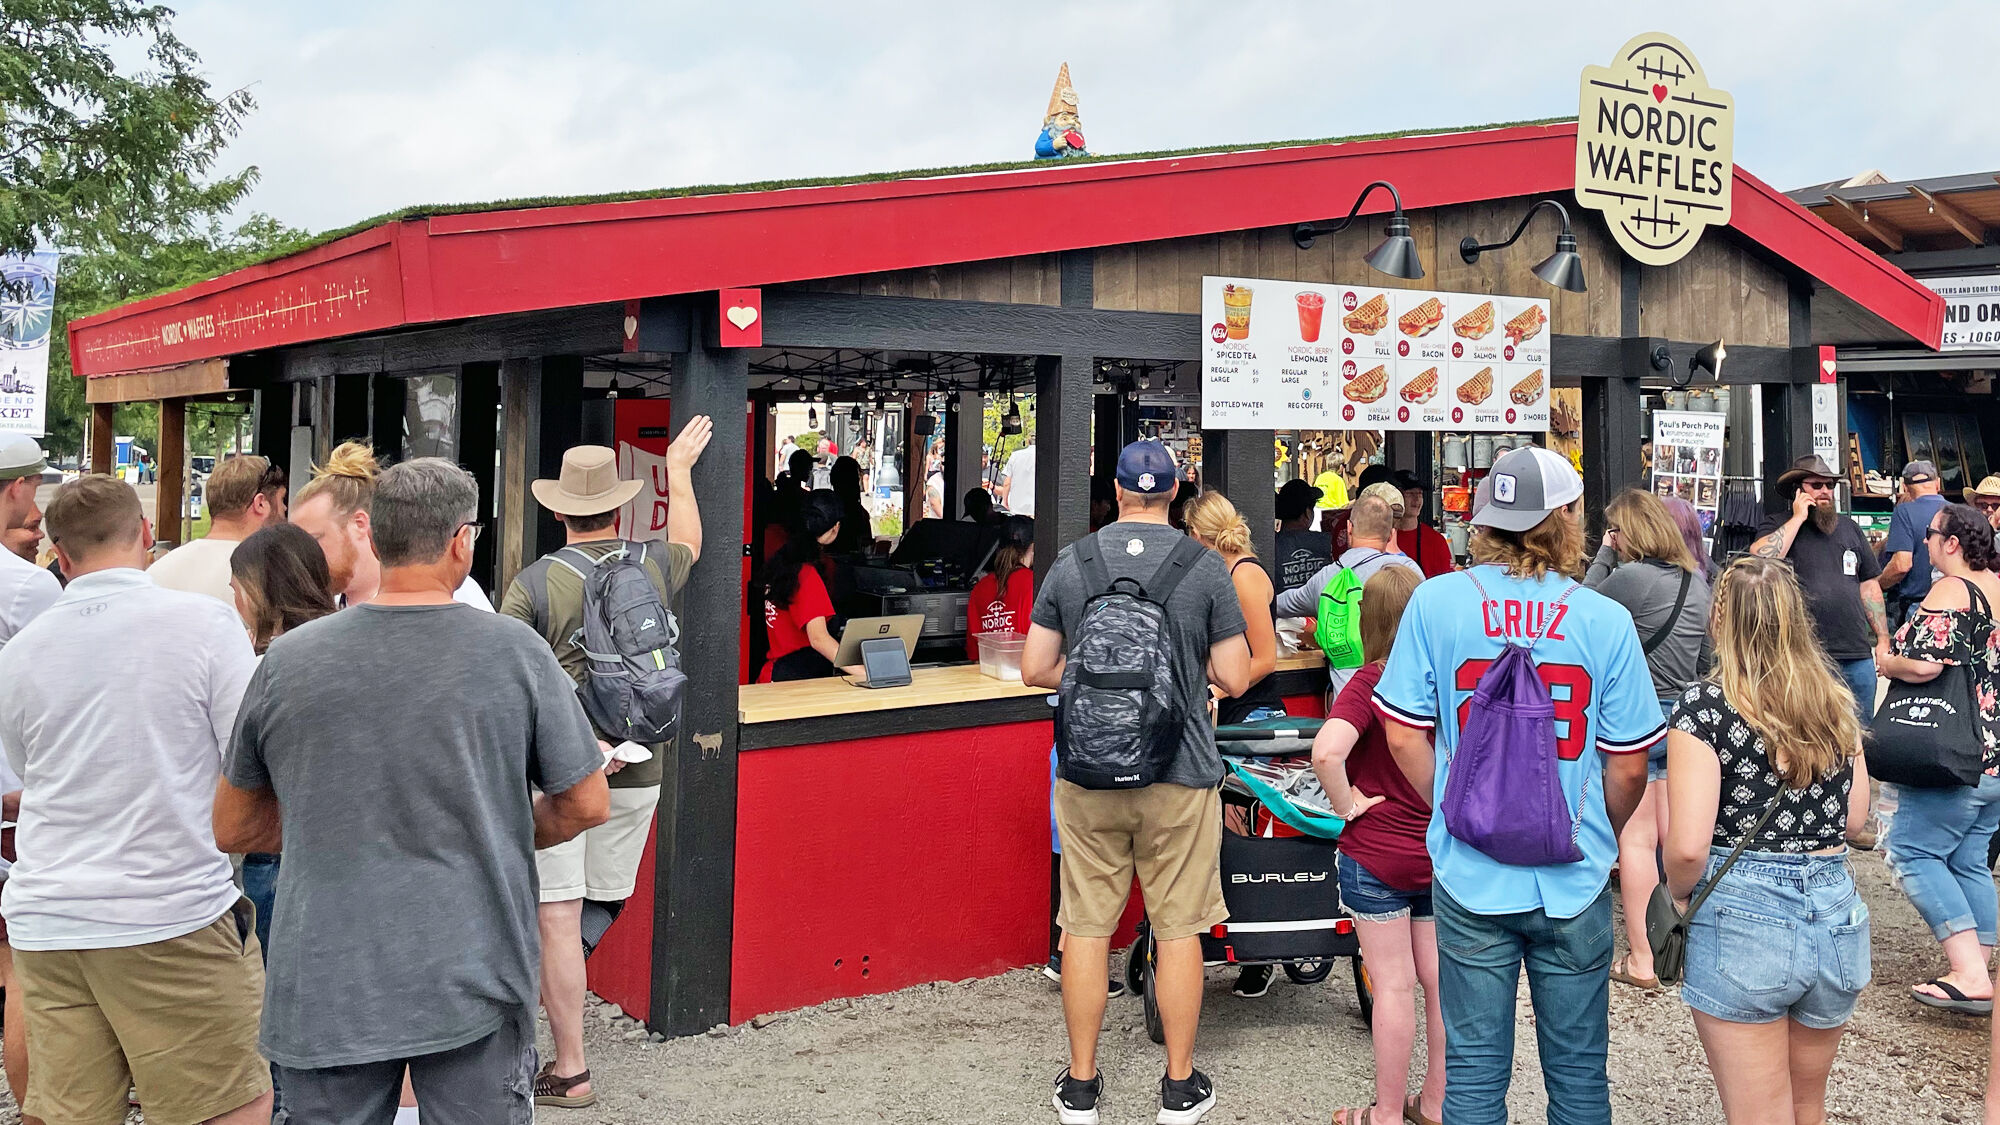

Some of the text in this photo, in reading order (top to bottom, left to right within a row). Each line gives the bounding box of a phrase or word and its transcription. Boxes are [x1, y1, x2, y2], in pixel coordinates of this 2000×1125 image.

[1598, 97, 1717, 151] NORDIC
[1588, 141, 1723, 196] WAFFLES
[1343, 296, 1357, 307] NEW
[162, 315, 215, 346] NORDIC WAFFLES
[1211, 328, 1228, 339] NEW
[1944, 332, 1957, 343] ES
[1217, 351, 1242, 359] SPICED
[1288, 346, 1312, 354] NORDIC
[1291, 355, 1328, 363] LEMONADE
[1342, 365, 1358, 376] NEW
[1815, 436, 1832, 446] ACTS
[1284, 561, 1324, 574] NORDIC
[1283, 572, 1314, 584] WAFF
[1482, 600, 1569, 641] CRUZ
[1232, 872, 1326, 883] BURLEY
